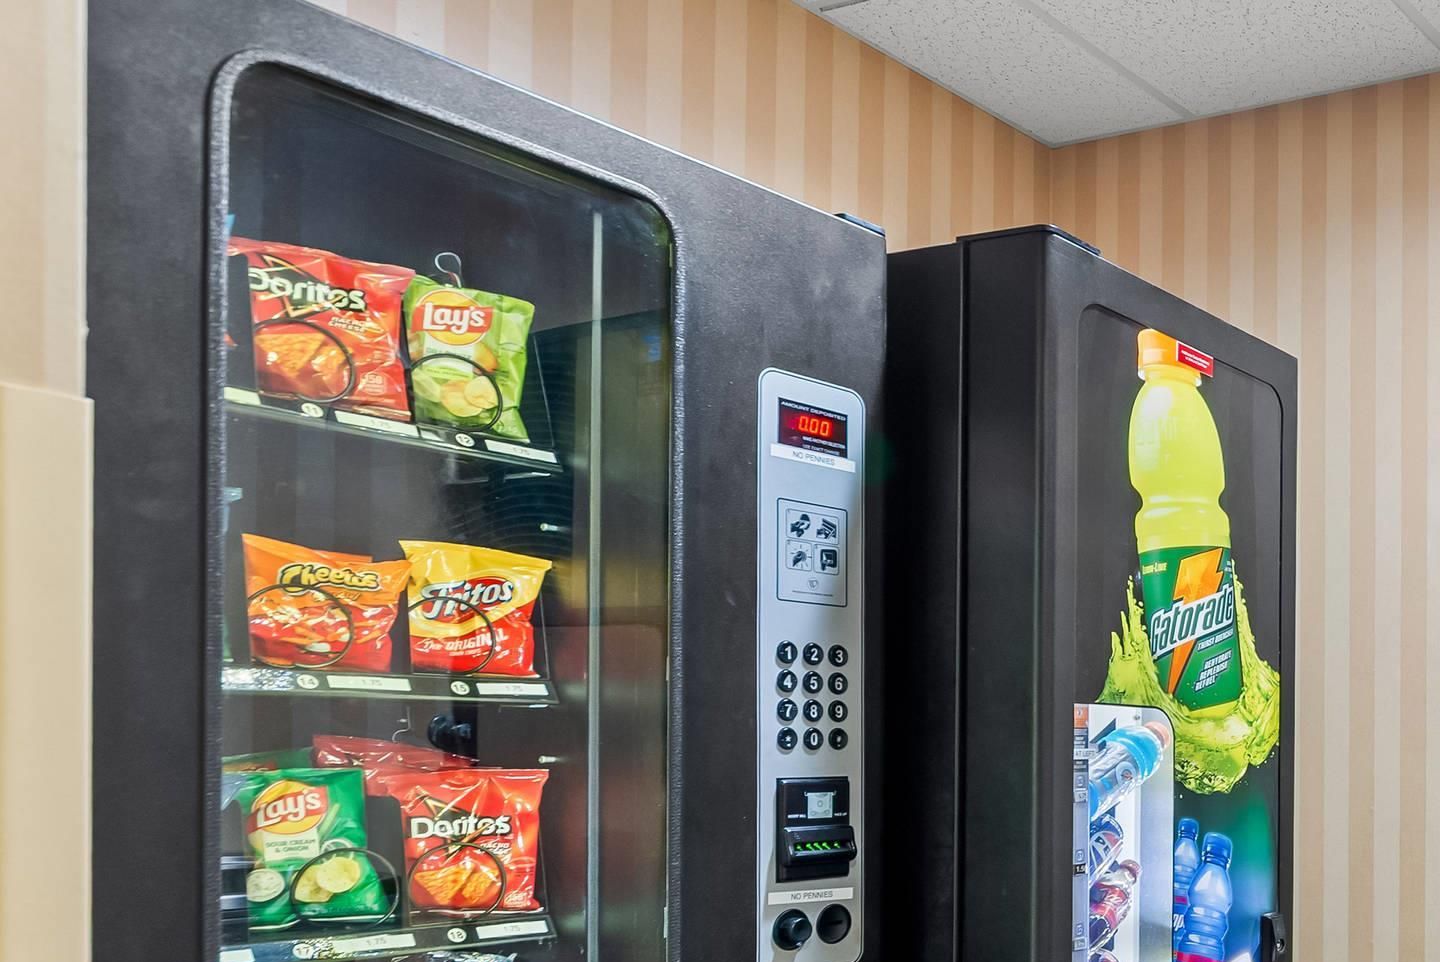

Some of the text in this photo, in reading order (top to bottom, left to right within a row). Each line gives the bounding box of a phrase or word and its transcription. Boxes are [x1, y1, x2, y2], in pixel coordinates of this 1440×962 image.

[422, 302, 486, 334] Lay's
[797, 415, 830, 437] 0.00
[792, 450, 836, 466] NO PENNIES
[279, 562, 380, 593] Cheetos
[421, 580, 514, 620] Fritos
[1151, 584, 1233, 656] Gatorade
[785, 645, 843, 663] 1 2 3
[783, 674, 843, 691] 4 5 6
[784, 704, 843, 718] 7 8 9
[810, 732, 818, 746] 0
[256, 790, 321, 828] Lay's
[411, 816, 512, 839] Doritos
[791, 891, 833, 901] NO PENNIES
[450, 930, 464, 940] 18
